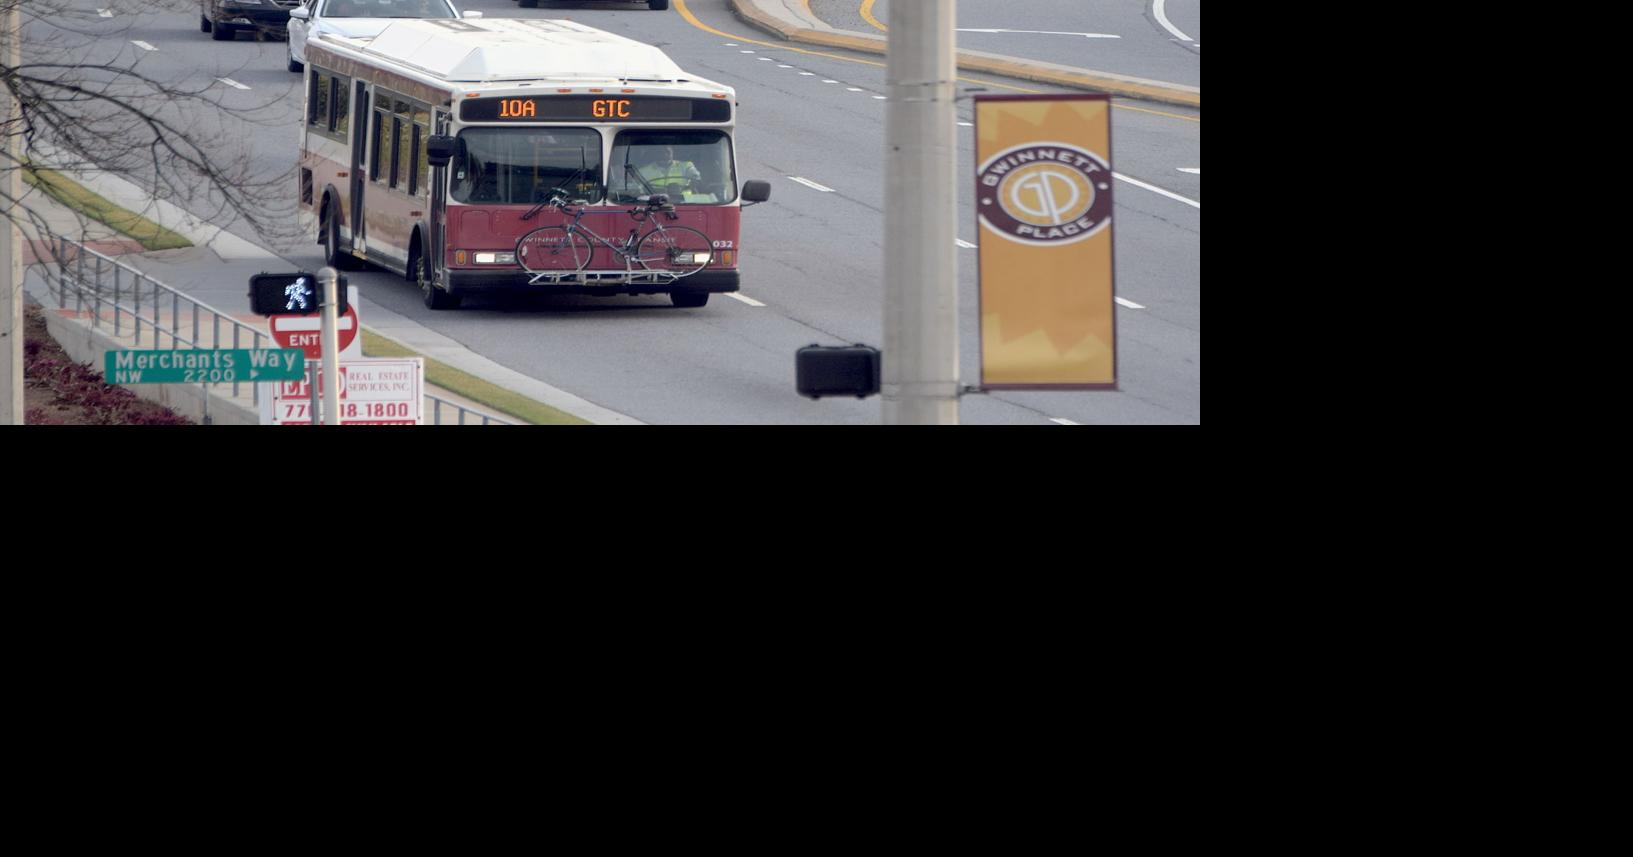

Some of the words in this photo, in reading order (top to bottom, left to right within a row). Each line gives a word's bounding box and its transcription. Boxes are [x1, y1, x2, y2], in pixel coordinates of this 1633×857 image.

[500, 99, 535, 117] 10A
[592, 99, 630, 117] GTC
[982, 149, 1101, 187] GWINNETT
[1016, 217, 1095, 238] PLACE
[712, 240, 733, 249] 032
[290, 334, 320, 346] ENT
[115, 351, 235, 369] Merchants
[249, 349, 297, 371] Way
[115, 370, 142, 383] NW
[184, 369, 236, 383] 2200
[349, 371, 373, 381] REAL
[378, 371, 409, 381] ESTATE
[392, 383, 409, 392] INC.
